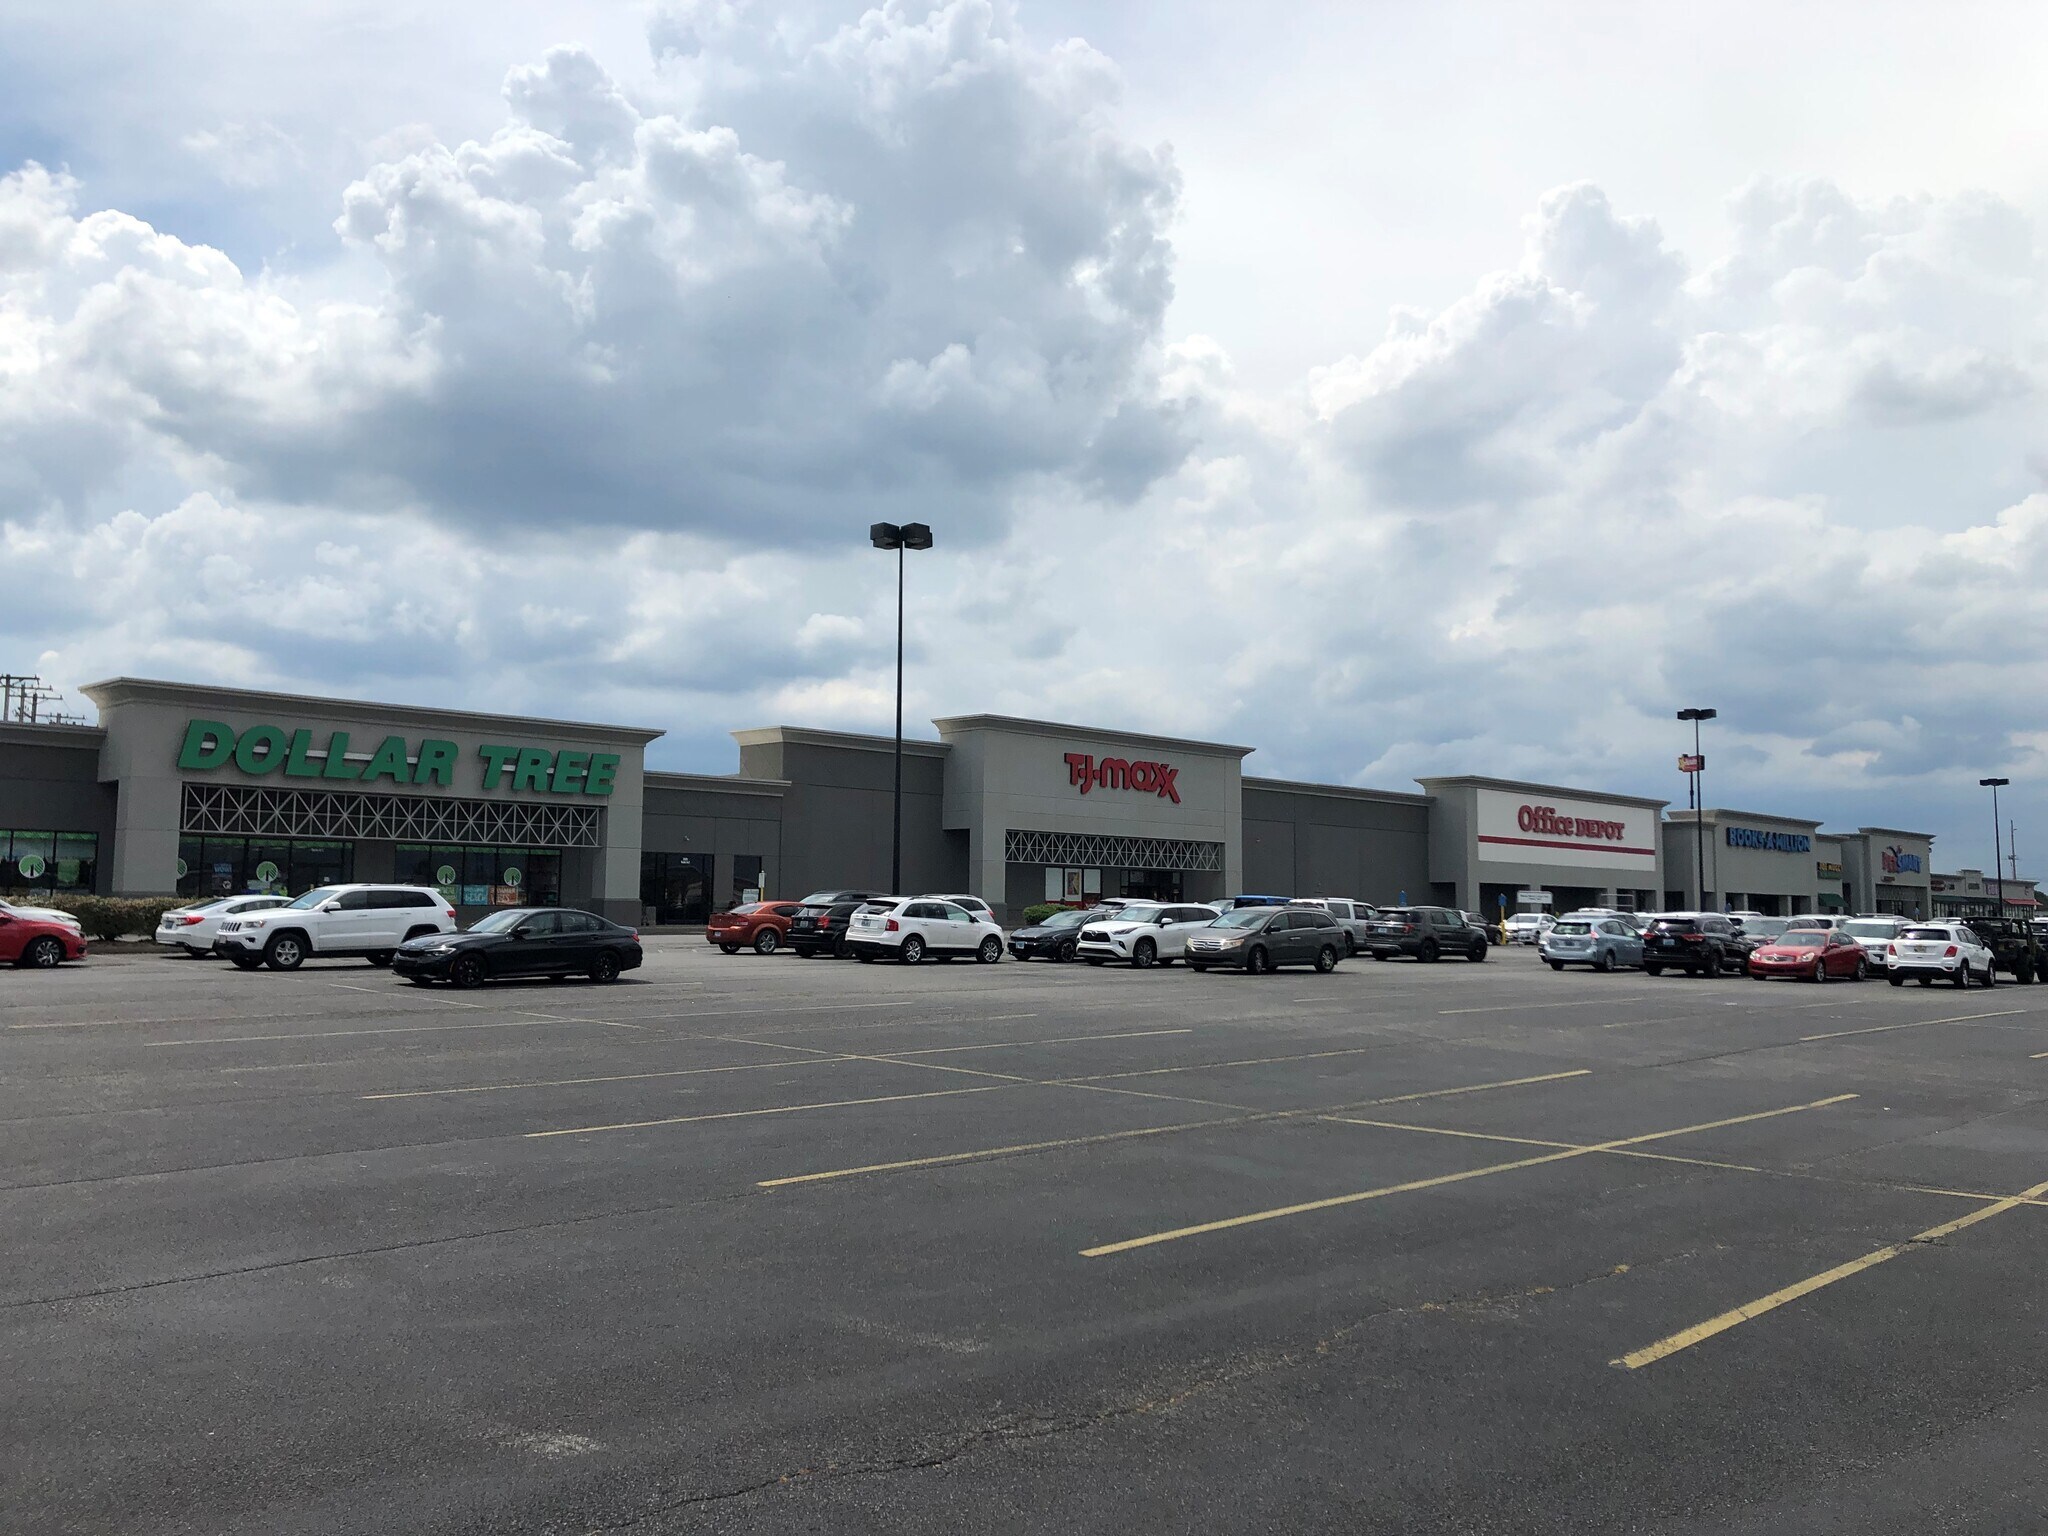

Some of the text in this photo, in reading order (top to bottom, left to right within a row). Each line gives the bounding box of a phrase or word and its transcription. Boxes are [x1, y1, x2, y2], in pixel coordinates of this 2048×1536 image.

[177, 719, 621, 795] DOLLAR TREE
[1518, 804, 1625, 841] Office DEPOT
